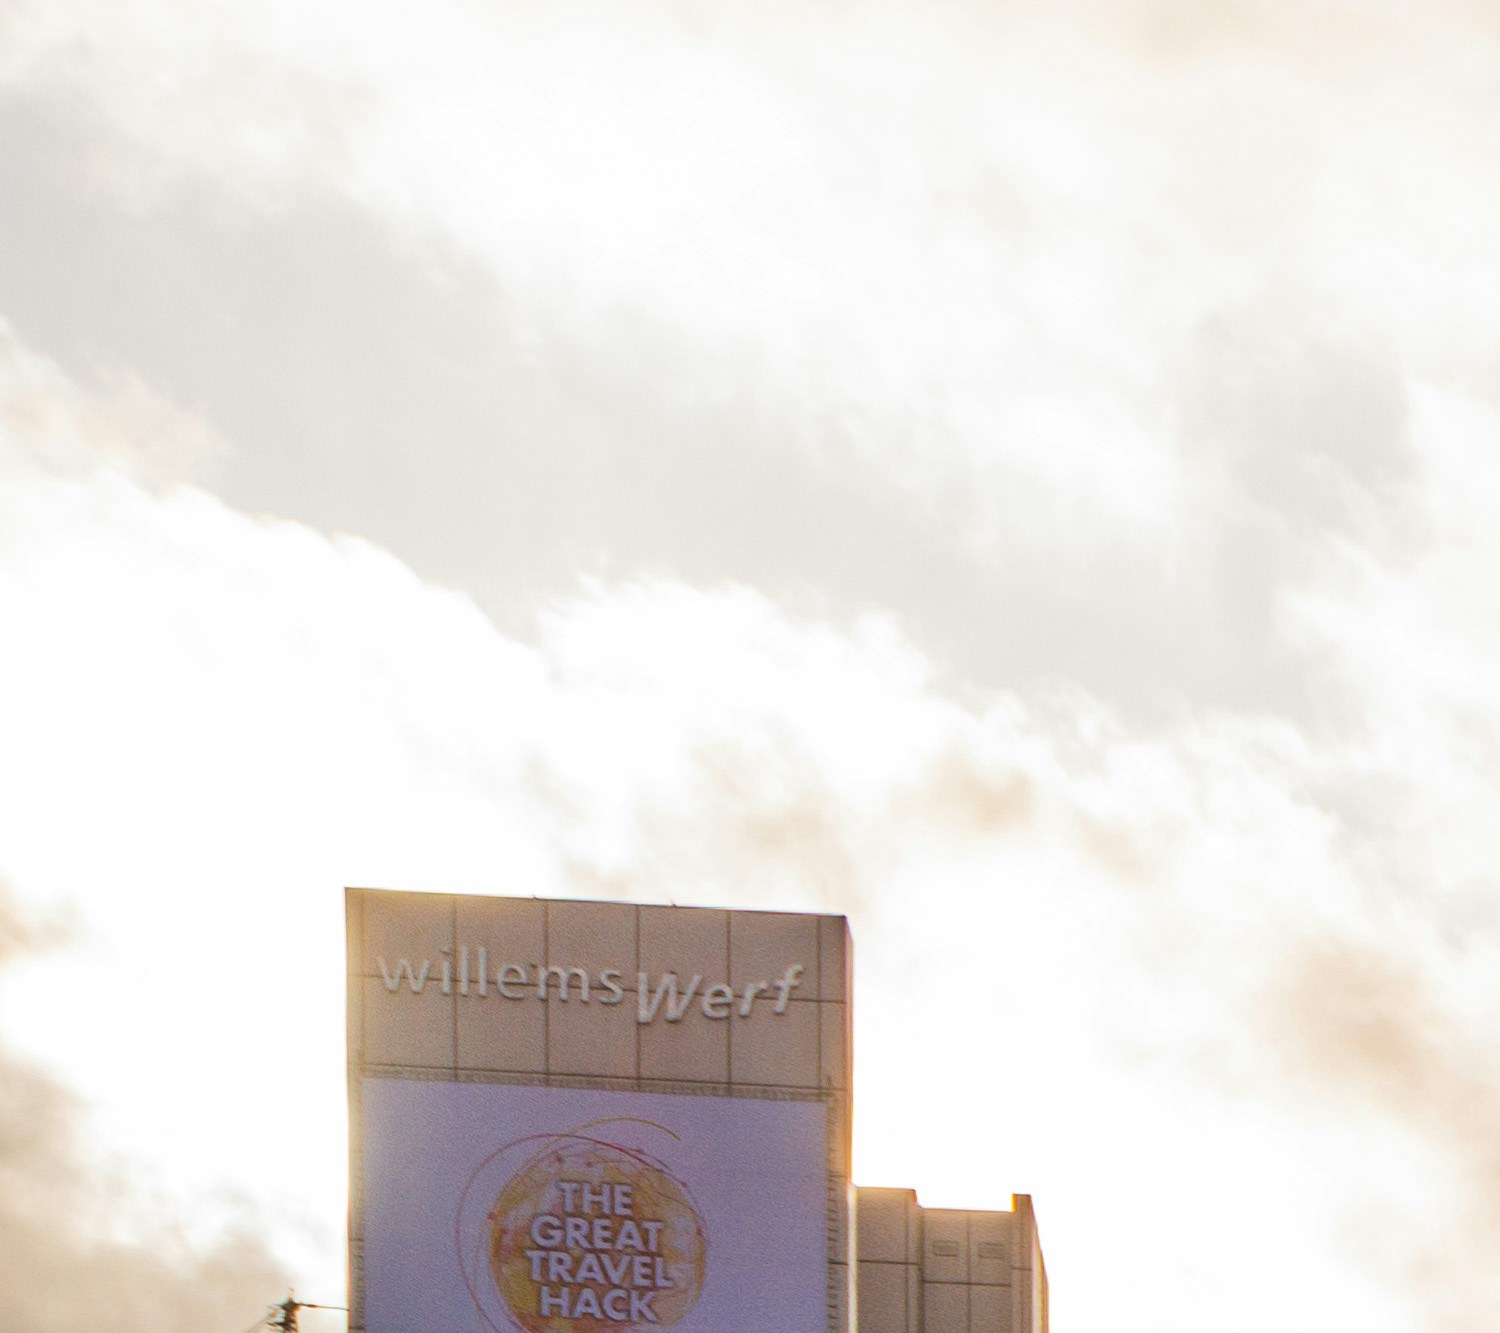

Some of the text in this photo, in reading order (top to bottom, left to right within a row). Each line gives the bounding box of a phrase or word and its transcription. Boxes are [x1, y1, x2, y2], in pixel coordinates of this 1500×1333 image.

[557, 1180, 634, 1217] THE
[529, 1216, 665, 1253] GREAT
[524, 1250, 674, 1288] TRAVEL
[538, 1287, 658, 1322] HACK
